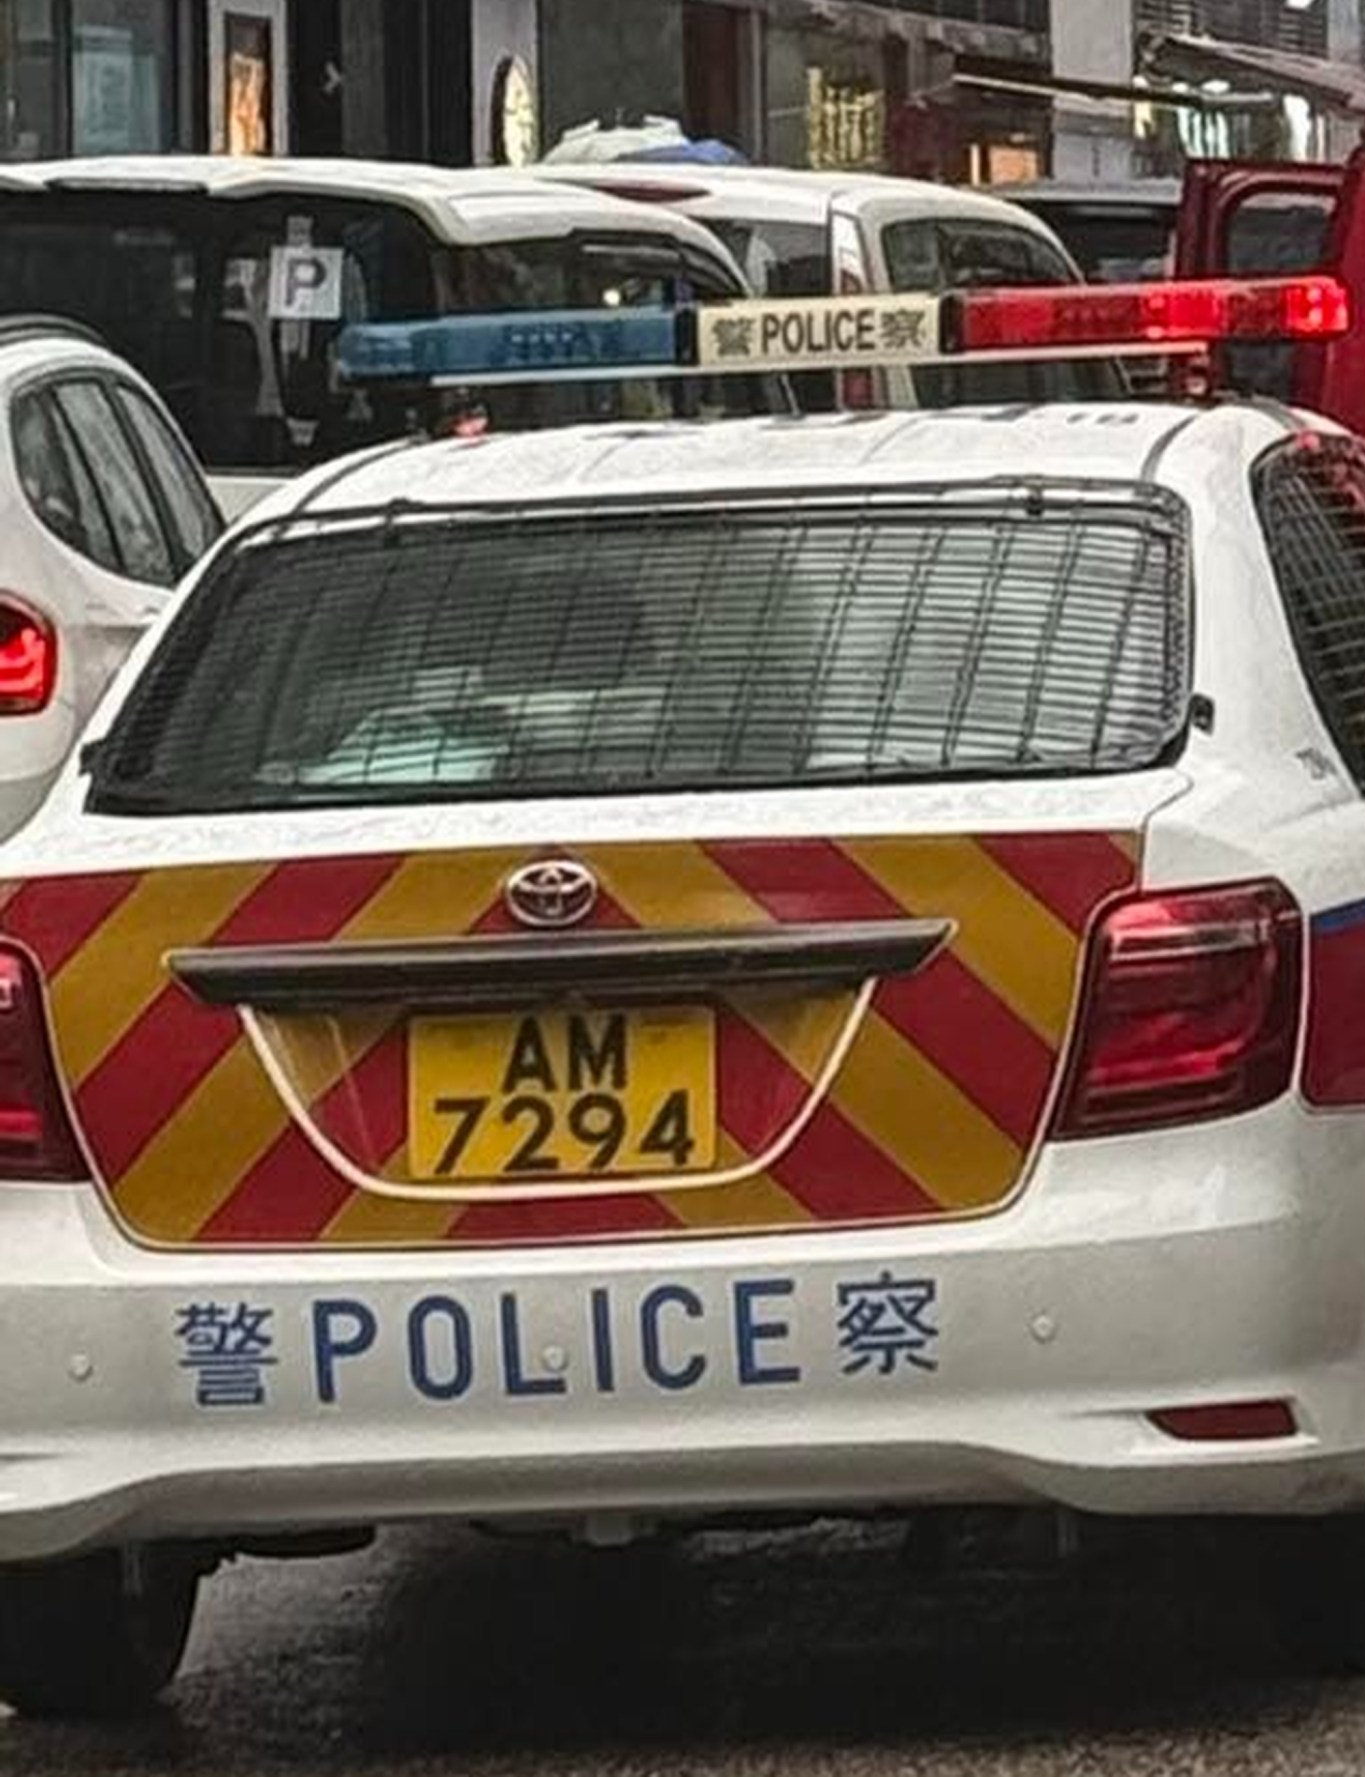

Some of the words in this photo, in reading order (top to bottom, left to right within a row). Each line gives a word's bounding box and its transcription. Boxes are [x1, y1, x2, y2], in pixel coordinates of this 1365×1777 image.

[285, 258, 328, 307] P
[761, 308, 876, 355] POLICE
[503, 1013, 628, 1092] AM
[433, 1089, 695, 1175] 7294
[174, 1300, 277, 1406] 警
[311, 1279, 800, 1403] POLICE
[836, 1270, 938, 1376] 察
